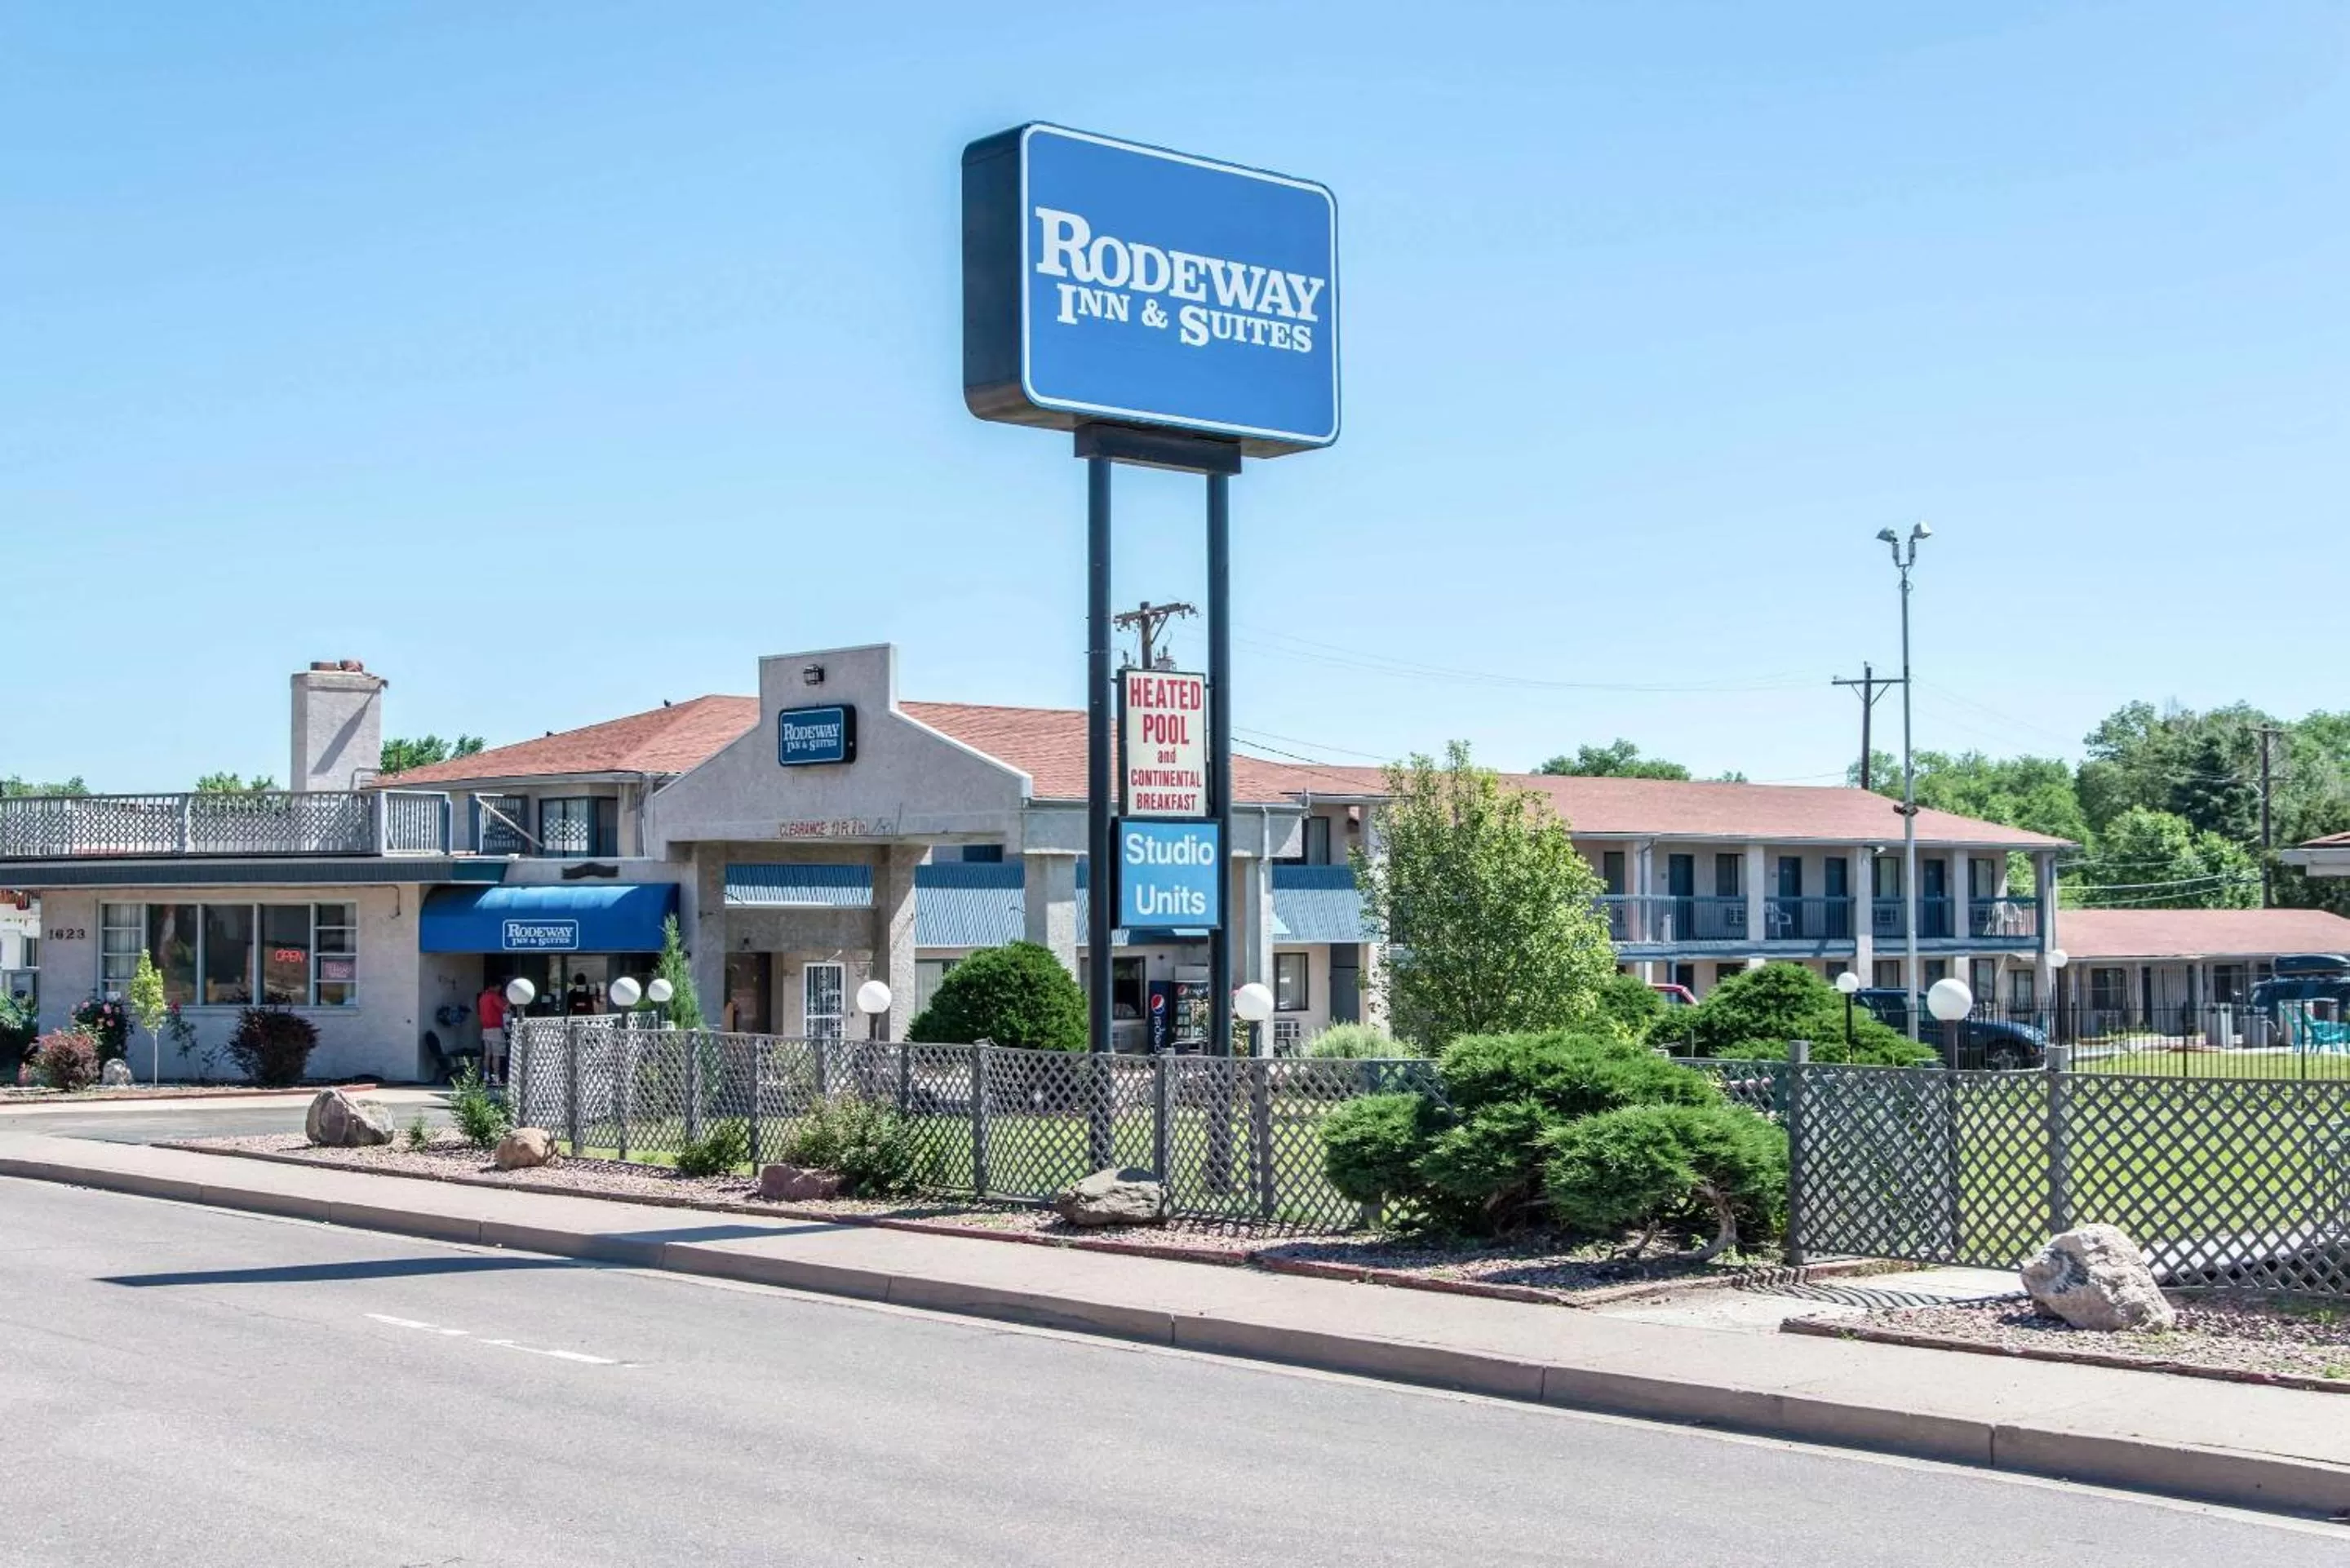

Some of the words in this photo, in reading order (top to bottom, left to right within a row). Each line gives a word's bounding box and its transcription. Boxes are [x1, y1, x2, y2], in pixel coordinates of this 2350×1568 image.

[1035, 206, 1324, 322] RODEWAY
[1057, 282, 1130, 326] INN
[1141, 298, 1168, 330] &
[1178, 304, 1312, 354] SUITES
[1129, 677, 1202, 711] HEATED
[783, 723, 840, 742] RODEWAY
[1142, 714, 1190, 746] POOL
[1157, 747, 1177, 764] and
[1130, 768, 1202, 788] CONTINENTAL
[1136, 791, 1197, 811] BREAKFAST
[1125, 832, 1215, 866] Studio
[1136, 884, 1206, 915] Units
[49, 928, 86, 940] 1623
[507, 923, 574, 937] RODEWAY
[275, 949, 305, 963] OPEN
